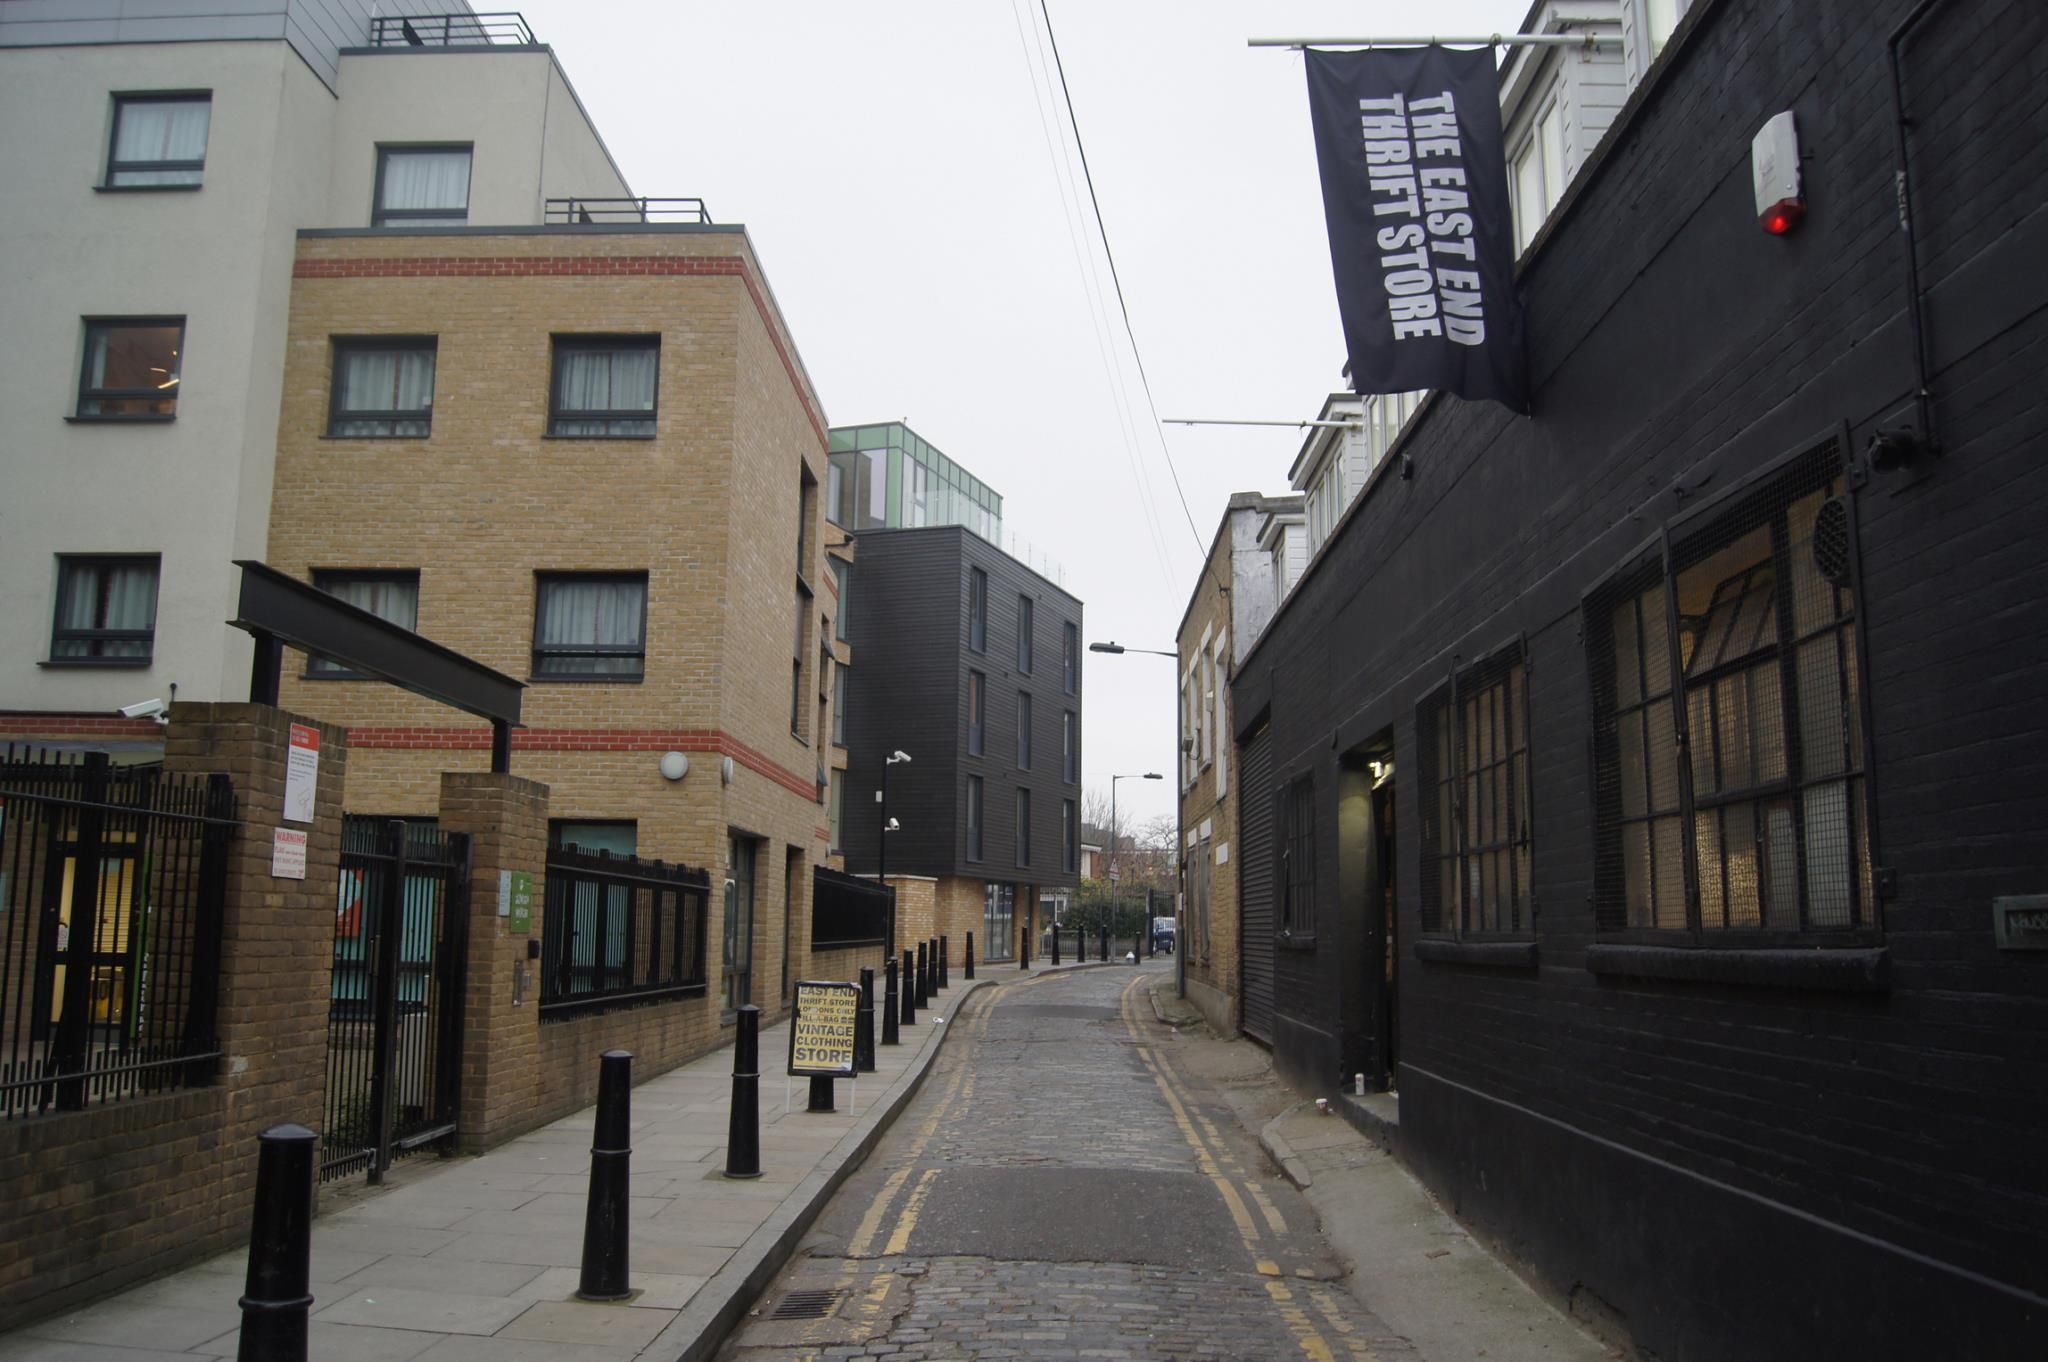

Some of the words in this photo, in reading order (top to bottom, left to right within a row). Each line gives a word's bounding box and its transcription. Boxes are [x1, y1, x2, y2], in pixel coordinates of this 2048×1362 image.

[1408, 91, 1461, 158] THE
[1359, 93, 1421, 217] THRIFT
[1419, 168, 1476, 261] EAST
[1376, 223, 1443, 341] STORE
[1436, 267, 1486, 346] END
[276, 831, 306, 844] WARNING
[800, 987, 828, 996] EAST
[832, 988, 856, 997] END
[797, 1036, 852, 1047] CLOTHING
[798, 1024, 853, 1036] VINTAGE
[796, 1048, 851, 1062] STORE
